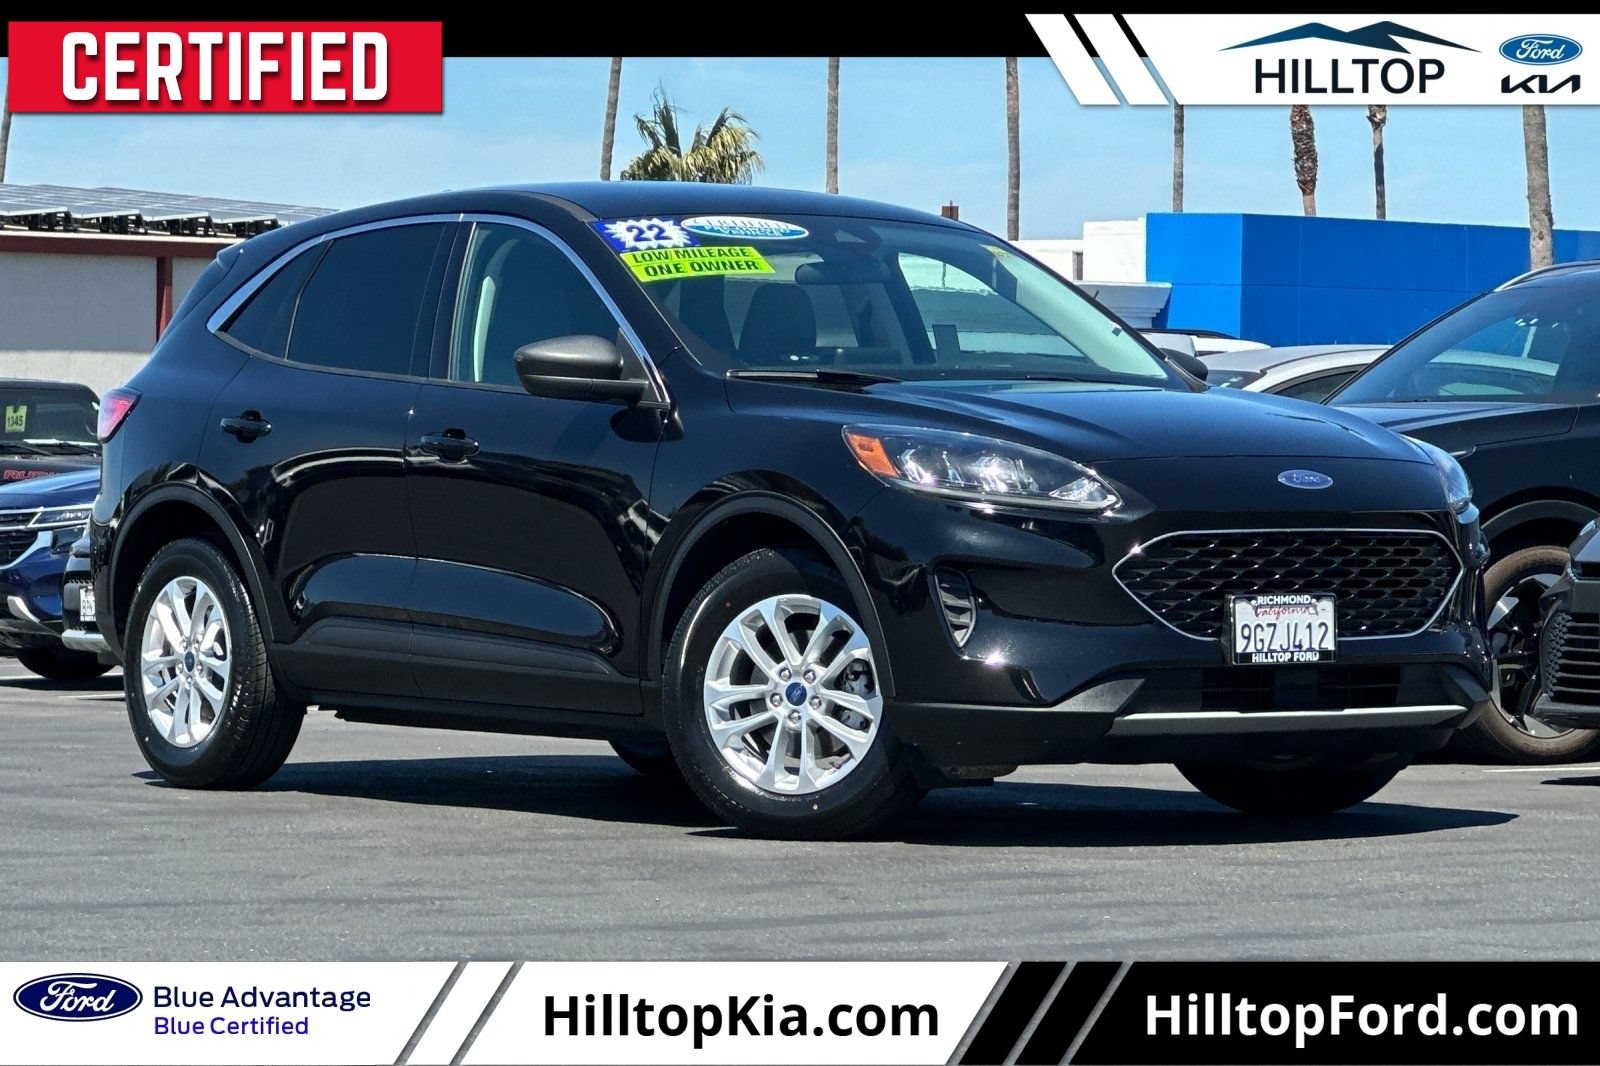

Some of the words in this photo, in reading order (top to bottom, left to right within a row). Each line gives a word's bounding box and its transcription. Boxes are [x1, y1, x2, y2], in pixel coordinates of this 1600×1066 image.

[626, 224, 669, 242] 22
[632, 251, 670, 263] LOW
[676, 248, 750, 259] MILEAGE
[644, 263, 685, 277] ONE
[692, 261, 759, 272] OWNER
[7, 415, 23, 426] 1345
[1257, 595, 1311, 605] RICHMOND
[1255, 605, 1310, 620] California
[1241, 622, 1329, 652] 9GZJ412
[1252, 653, 1291, 663] HILLTOP
[1293, 651, 1320, 662] FORD
